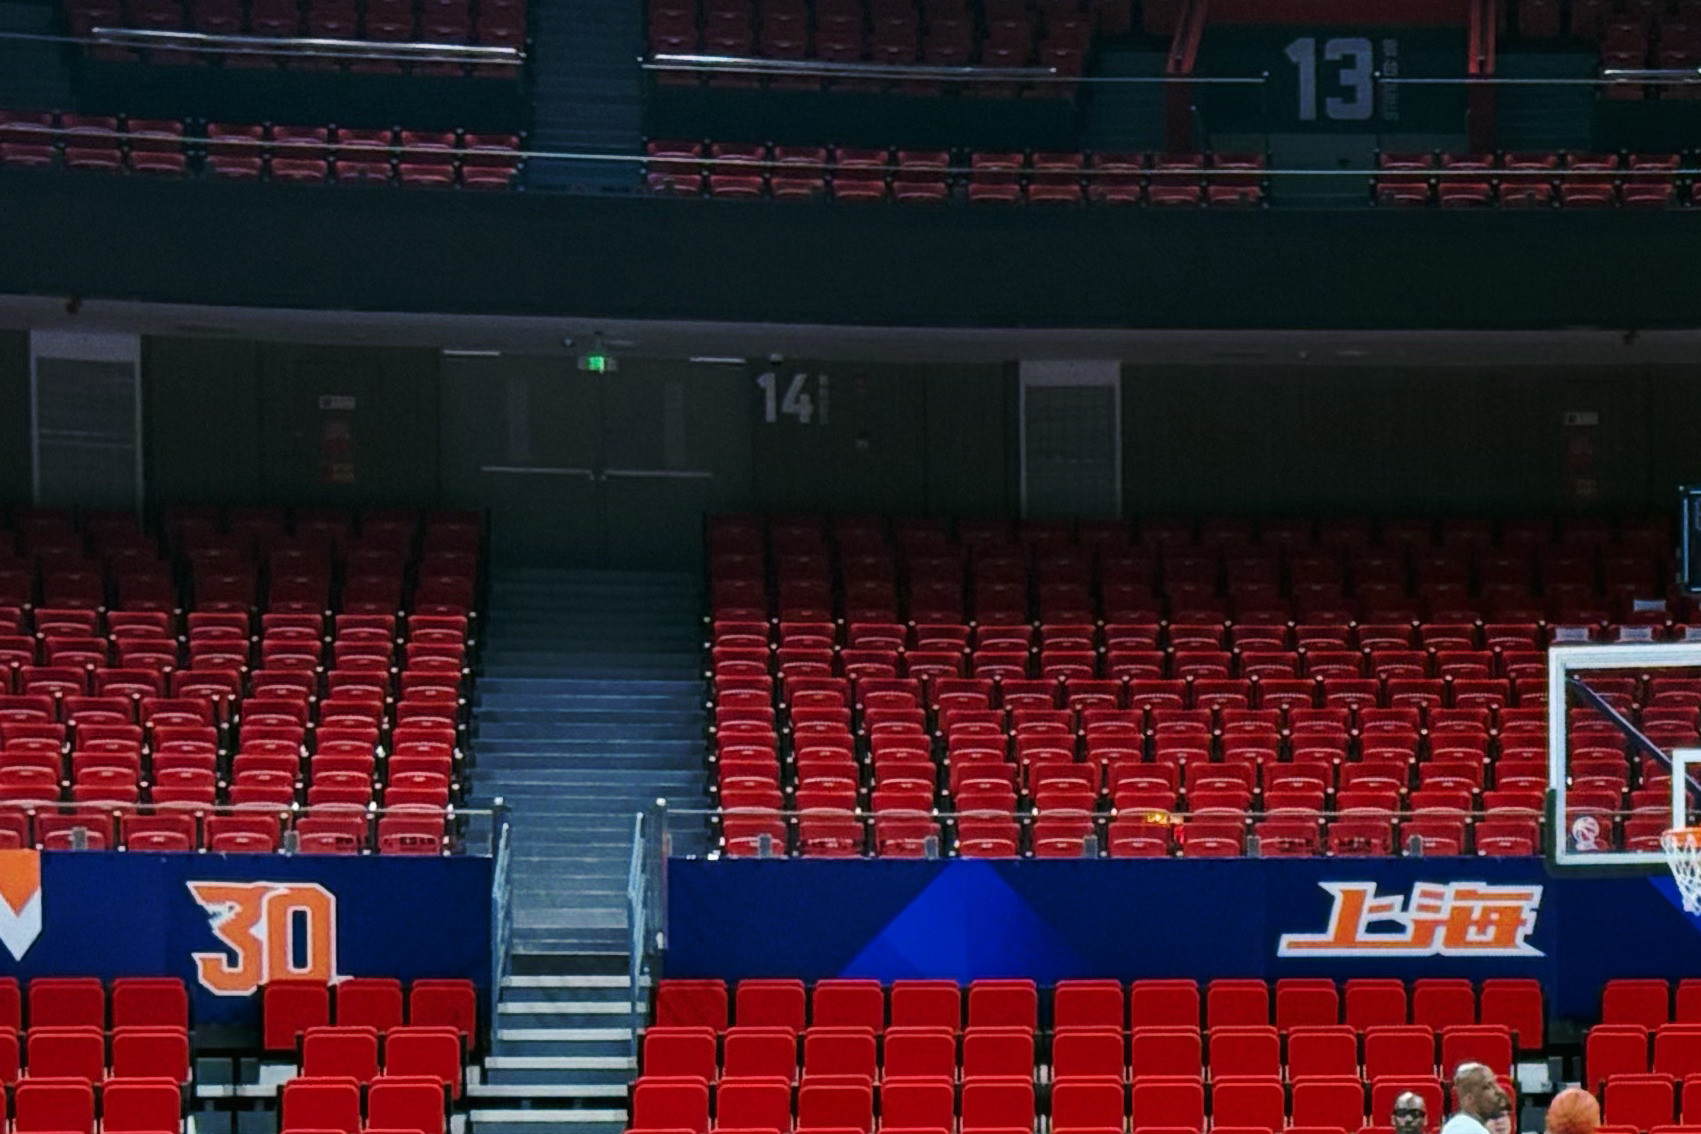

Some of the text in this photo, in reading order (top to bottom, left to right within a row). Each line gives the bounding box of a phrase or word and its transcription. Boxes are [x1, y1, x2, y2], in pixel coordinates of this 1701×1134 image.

[1284, 37, 1374, 121] 13
[756, 372, 813, 424] 14
[186, 881, 354, 995] 30
[1277, 881, 1547, 957] 上海
